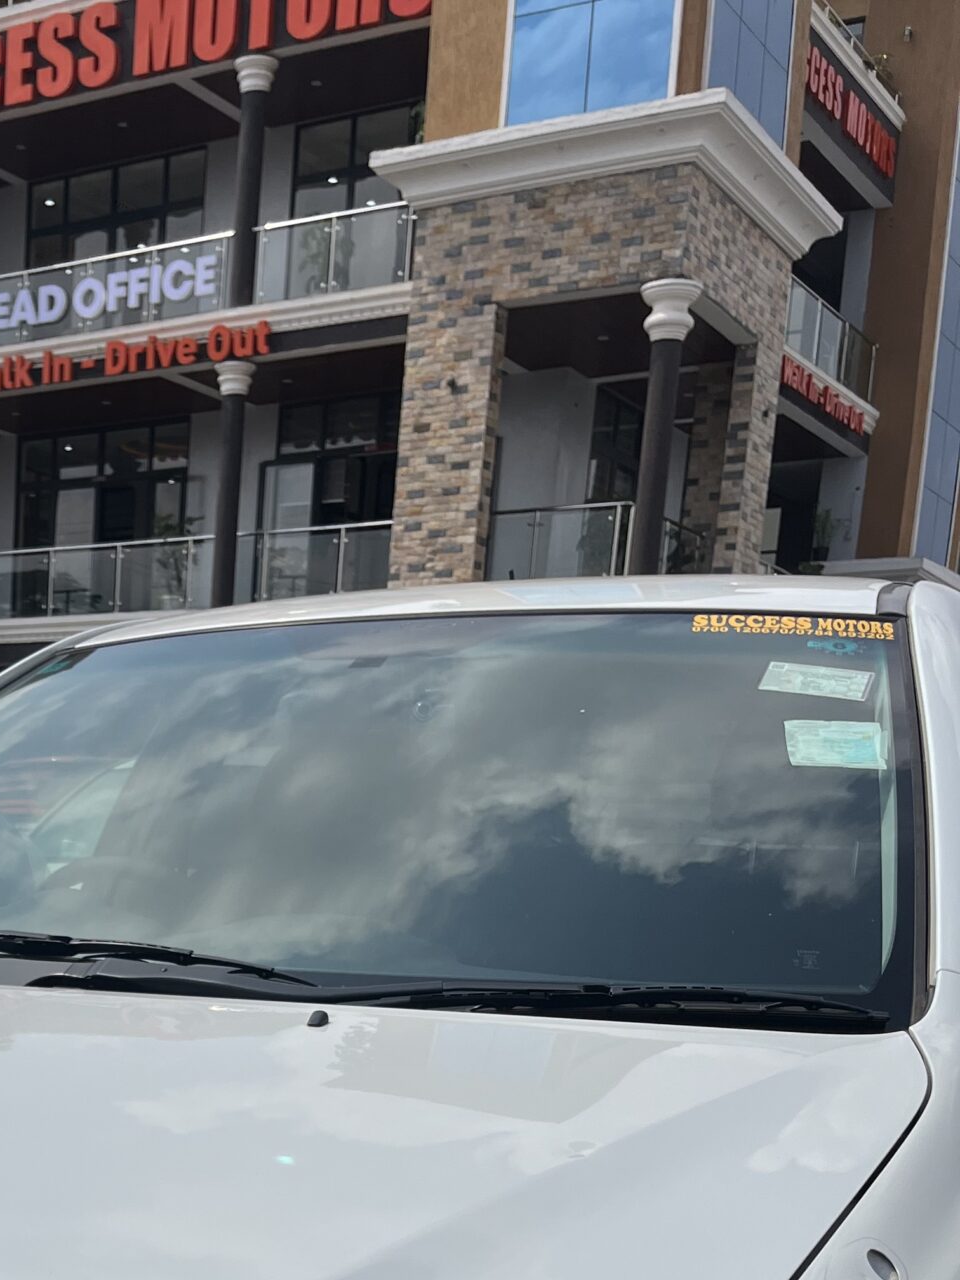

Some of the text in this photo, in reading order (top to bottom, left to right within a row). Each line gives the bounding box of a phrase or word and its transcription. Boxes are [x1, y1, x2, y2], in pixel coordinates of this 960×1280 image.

[805, 40, 897, 178] CESS MOTORS
[73, 254, 219, 319] OFFICE
[42, 350, 73, 384] In
[104, 335, 199, 376] Drive
[206, 320, 273, 362] Out
[692, 614, 895, 635] SUCCESS MOTORS
